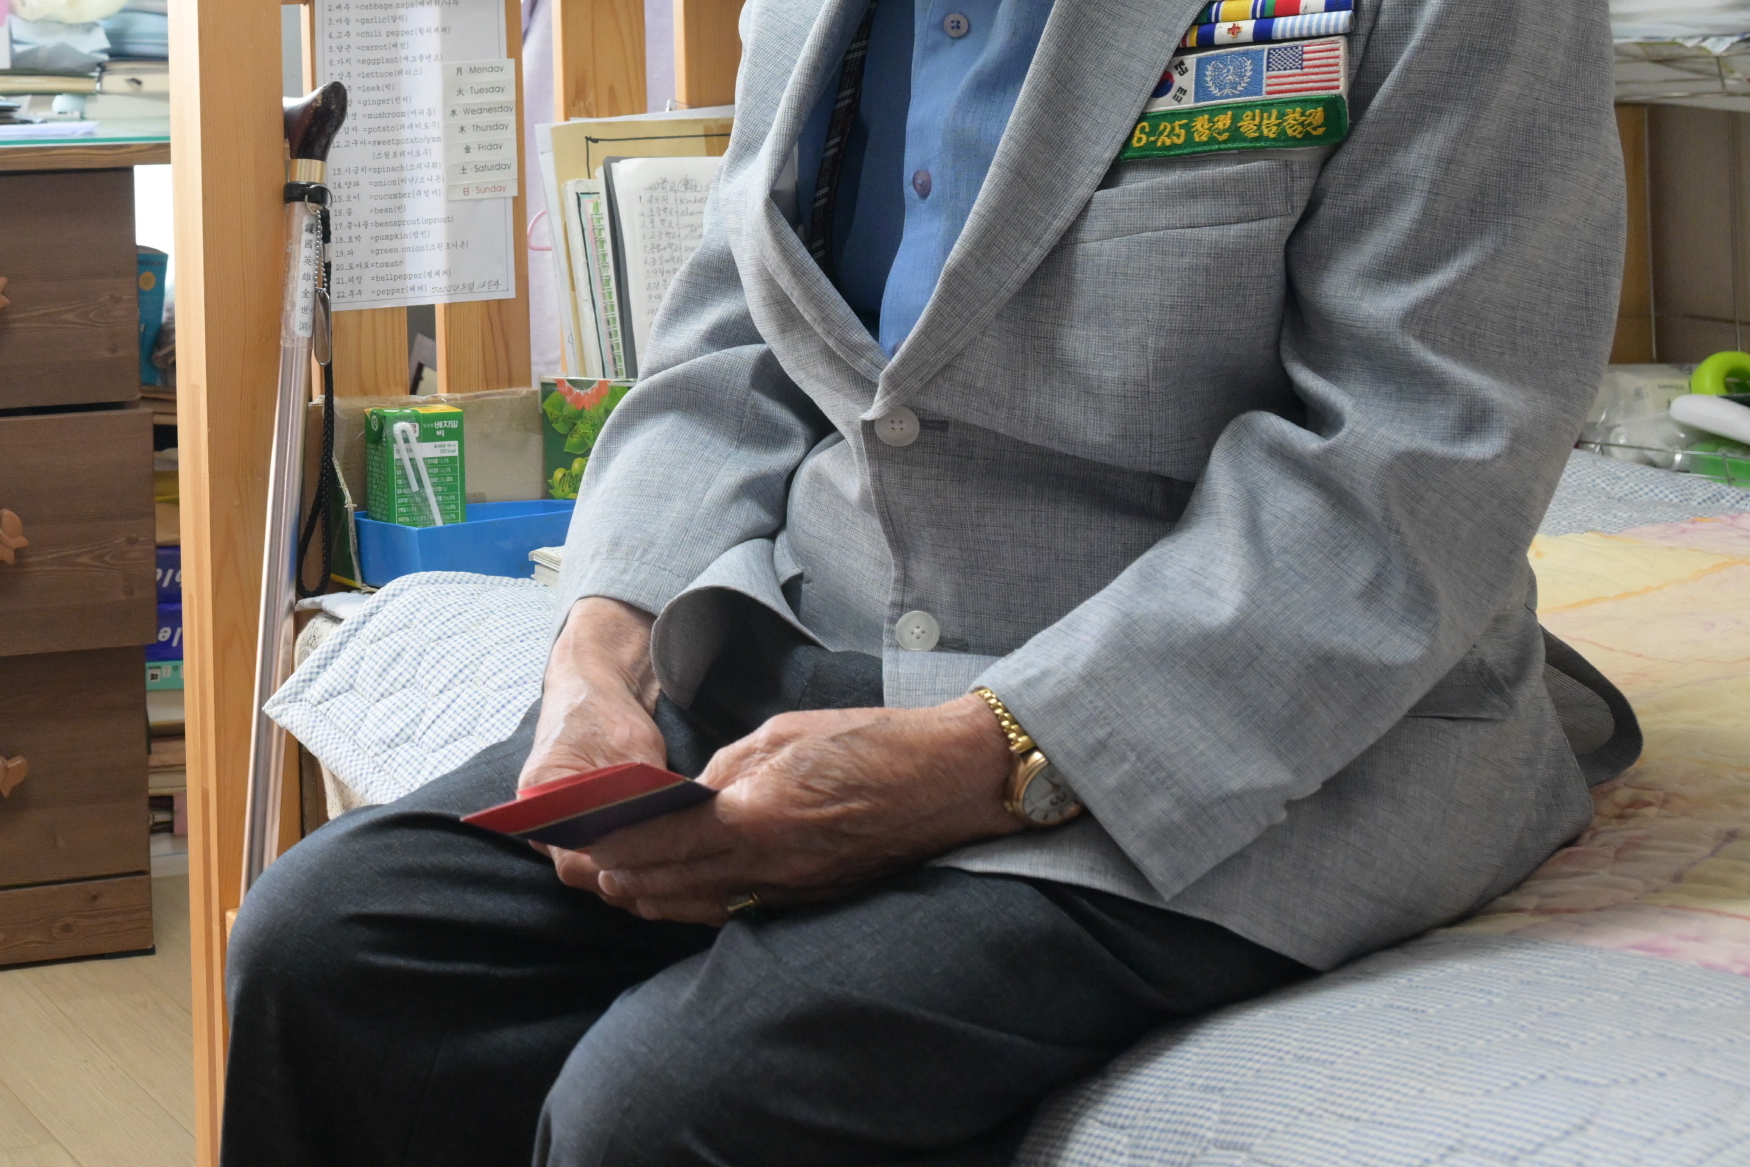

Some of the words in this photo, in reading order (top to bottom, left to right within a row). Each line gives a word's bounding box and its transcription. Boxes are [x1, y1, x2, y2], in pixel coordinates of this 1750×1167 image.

[456, 66, 463, 75] 月
[469, 65, 504, 75] Monday
[456, 87, 464, 96] 火
[470, 85, 506, 95] Tuesday
[450, 109, 458, 117] 水
[463, 105, 514, 115] Wednesday
[458, 125, 466, 134] 木
[472, 122, 510, 132] Thursday
[1191, 111, 1233, 142] 참전
[463, 144, 472, 154] 金
[477, 143, 503, 152] Friday
[460, 165, 468, 174] 土
[473, 162, 512, 173] Saturday
[463, 187, 470, 196] 日
[475, 185, 507, 195] Sunday
[434, 420, 458, 429] 베지밀
